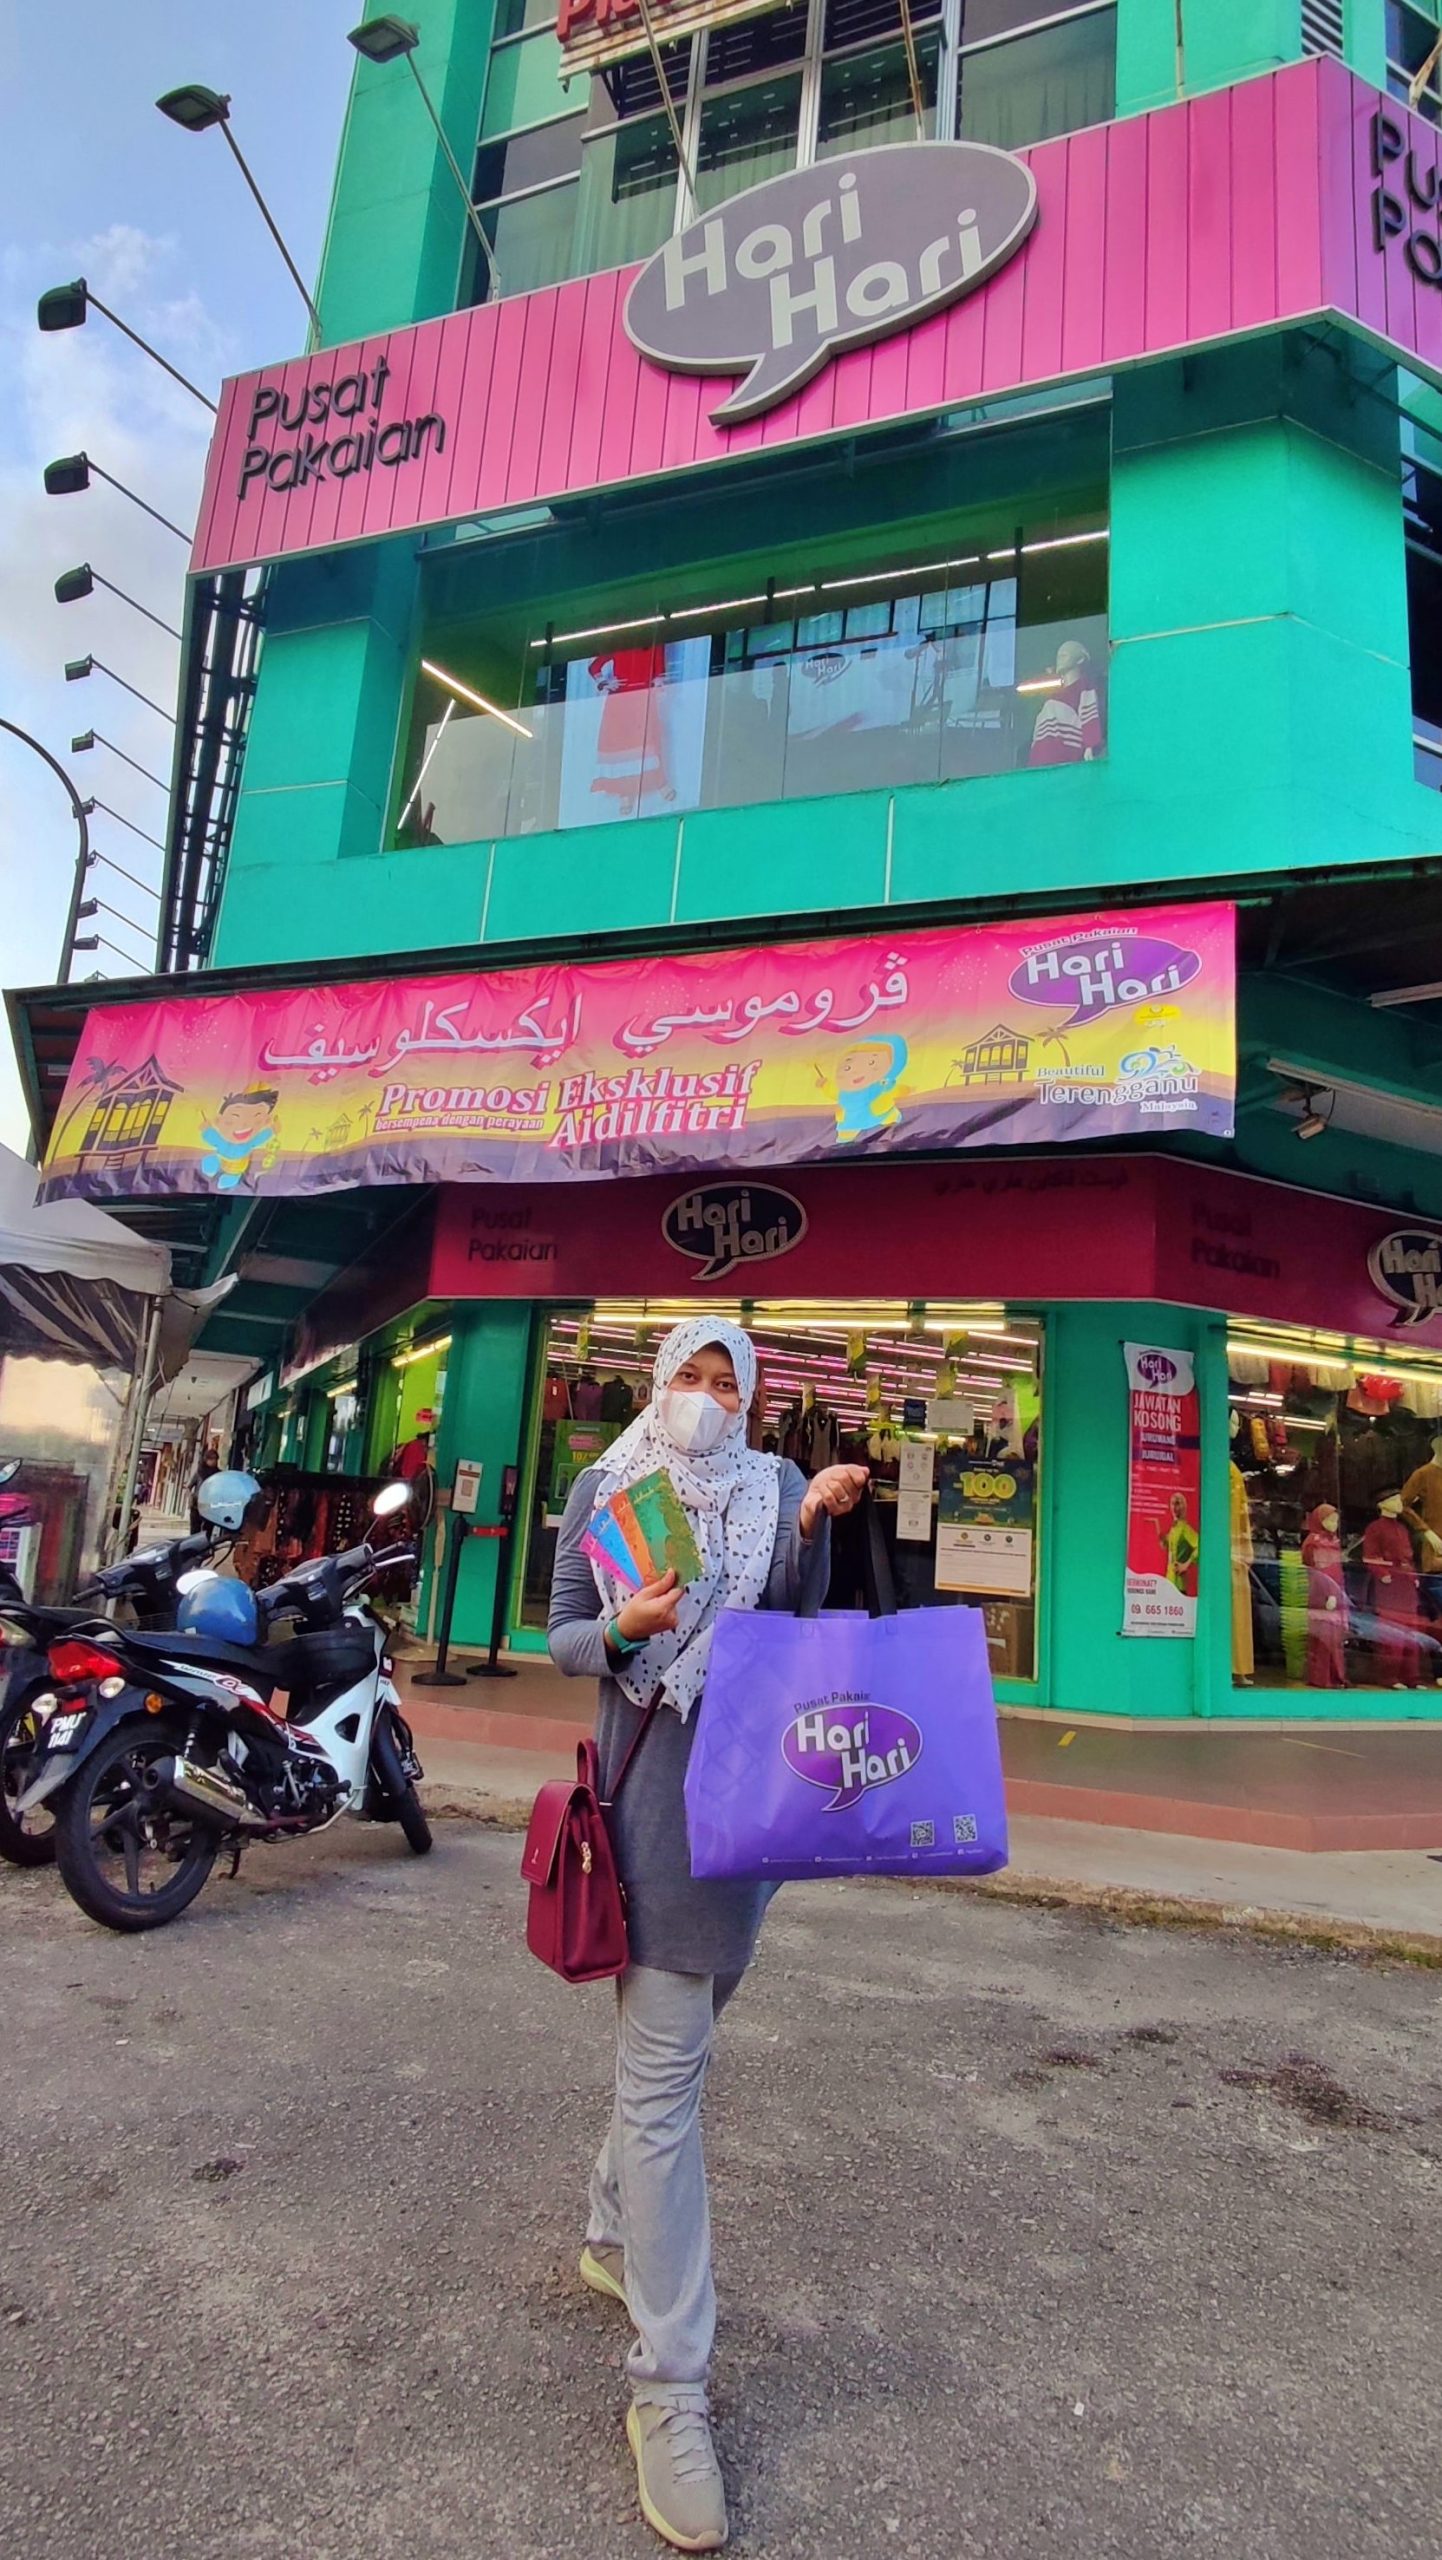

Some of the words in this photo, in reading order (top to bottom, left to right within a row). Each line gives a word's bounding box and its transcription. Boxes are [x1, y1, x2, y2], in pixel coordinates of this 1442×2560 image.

[664, 172, 862, 311] Hari
[769, 208, 982, 350] Hari
[247, 355, 389, 441] Pusat
[237, 412, 445, 500] Pakaian
[1020, 936, 1071, 957] Pusat
[1070, 927, 1138, 943] Pakaian
[1027, 942, 1124, 985] Hari
[1080, 964, 1180, 1006] Hari
[379, 1081, 552, 1115] Promosi
[556, 1060, 761, 1112] Eksklusif
[1037, 1065, 1105, 1077] Beautiful
[1035, 1074, 1198, 1106] Terengganu
[375, 1114, 439, 1132] bersempena
[440, 1115, 485, 1129] dengan
[486, 1116, 544, 1131] perayaan
[549, 1098, 746, 1147] Aidilfitri
[471, 1206, 533, 1230] Pusat
[677, 1189, 751, 1231] Hari
[467, 1238, 558, 1262] Pakaian
[713, 1216, 788, 1258] Hari
[1380, 1240, 1441, 1274] Hari
[1141, 1358, 1162, 1369] Hari
[1134, 1392, 1181, 1414] JAWATAN
[1134, 1410, 1182, 1432] KOSONG
[960, 1471, 1017, 1500] 100
[1164, 1605, 1184, 1617] 1860
[793, 1695, 830, 1714] Pusat
[797, 1711, 869, 1753] Hari
[841, 1738, 911, 1789] Hari
